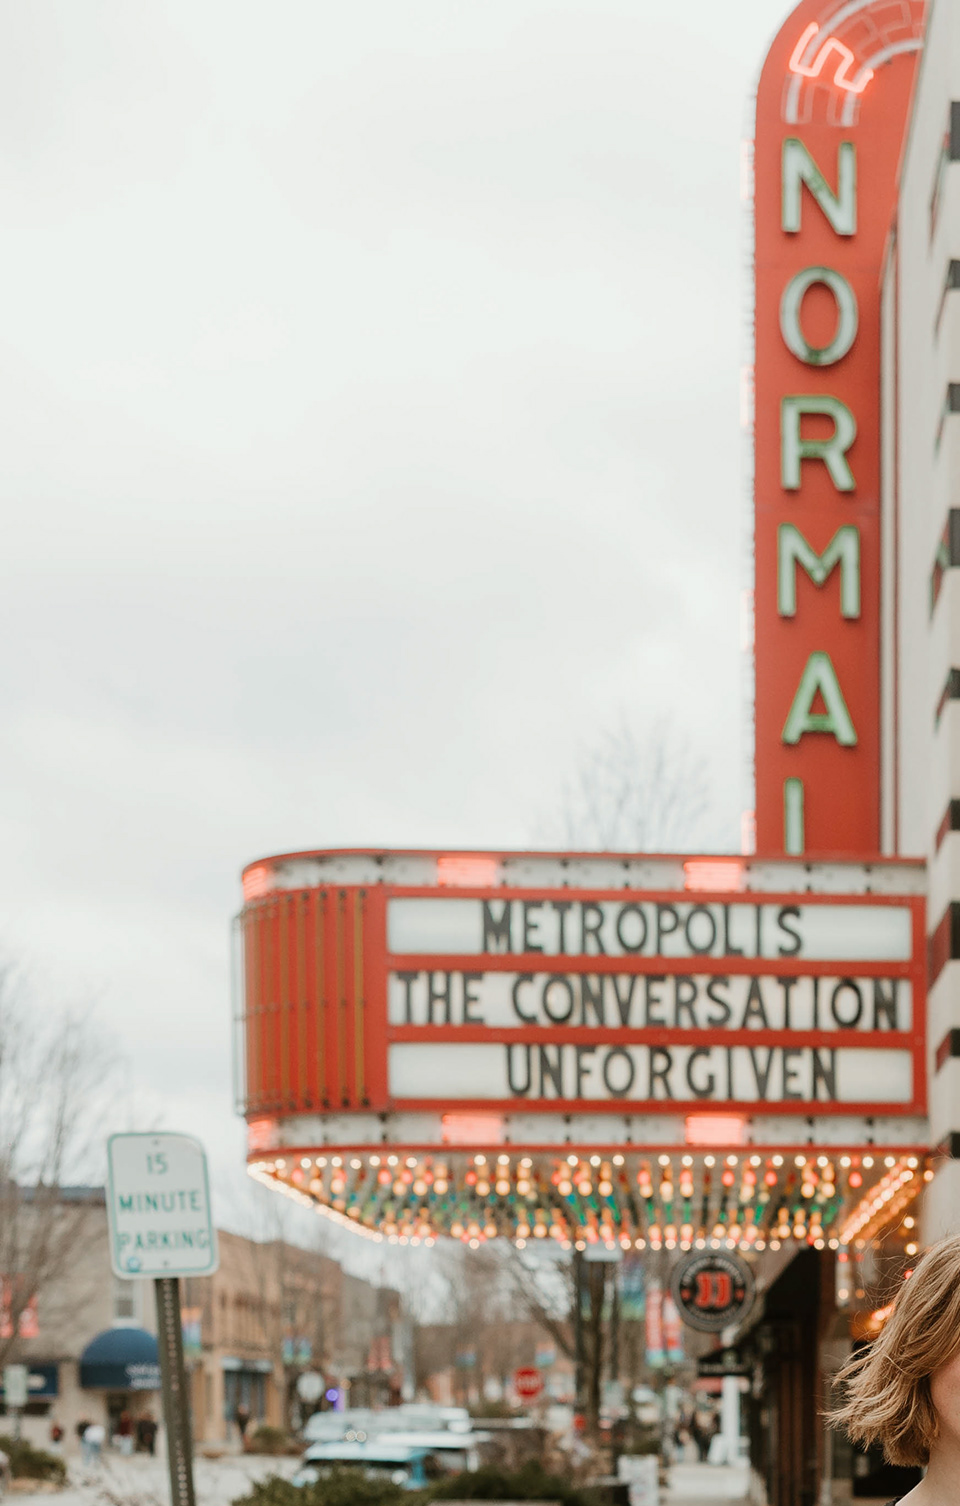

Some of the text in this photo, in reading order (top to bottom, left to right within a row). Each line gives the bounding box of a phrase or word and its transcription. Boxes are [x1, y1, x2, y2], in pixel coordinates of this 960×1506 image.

[482, 900, 803, 956] METROPOLIS
[396, 970, 898, 1030] THE CONVERSATION
[506, 1044, 837, 1099] UNFORGIVEN
[146, 1153, 169, 1175] 15
[118, 1190, 202, 1213] MINUTE
[116, 1229, 210, 1250] PARKING
